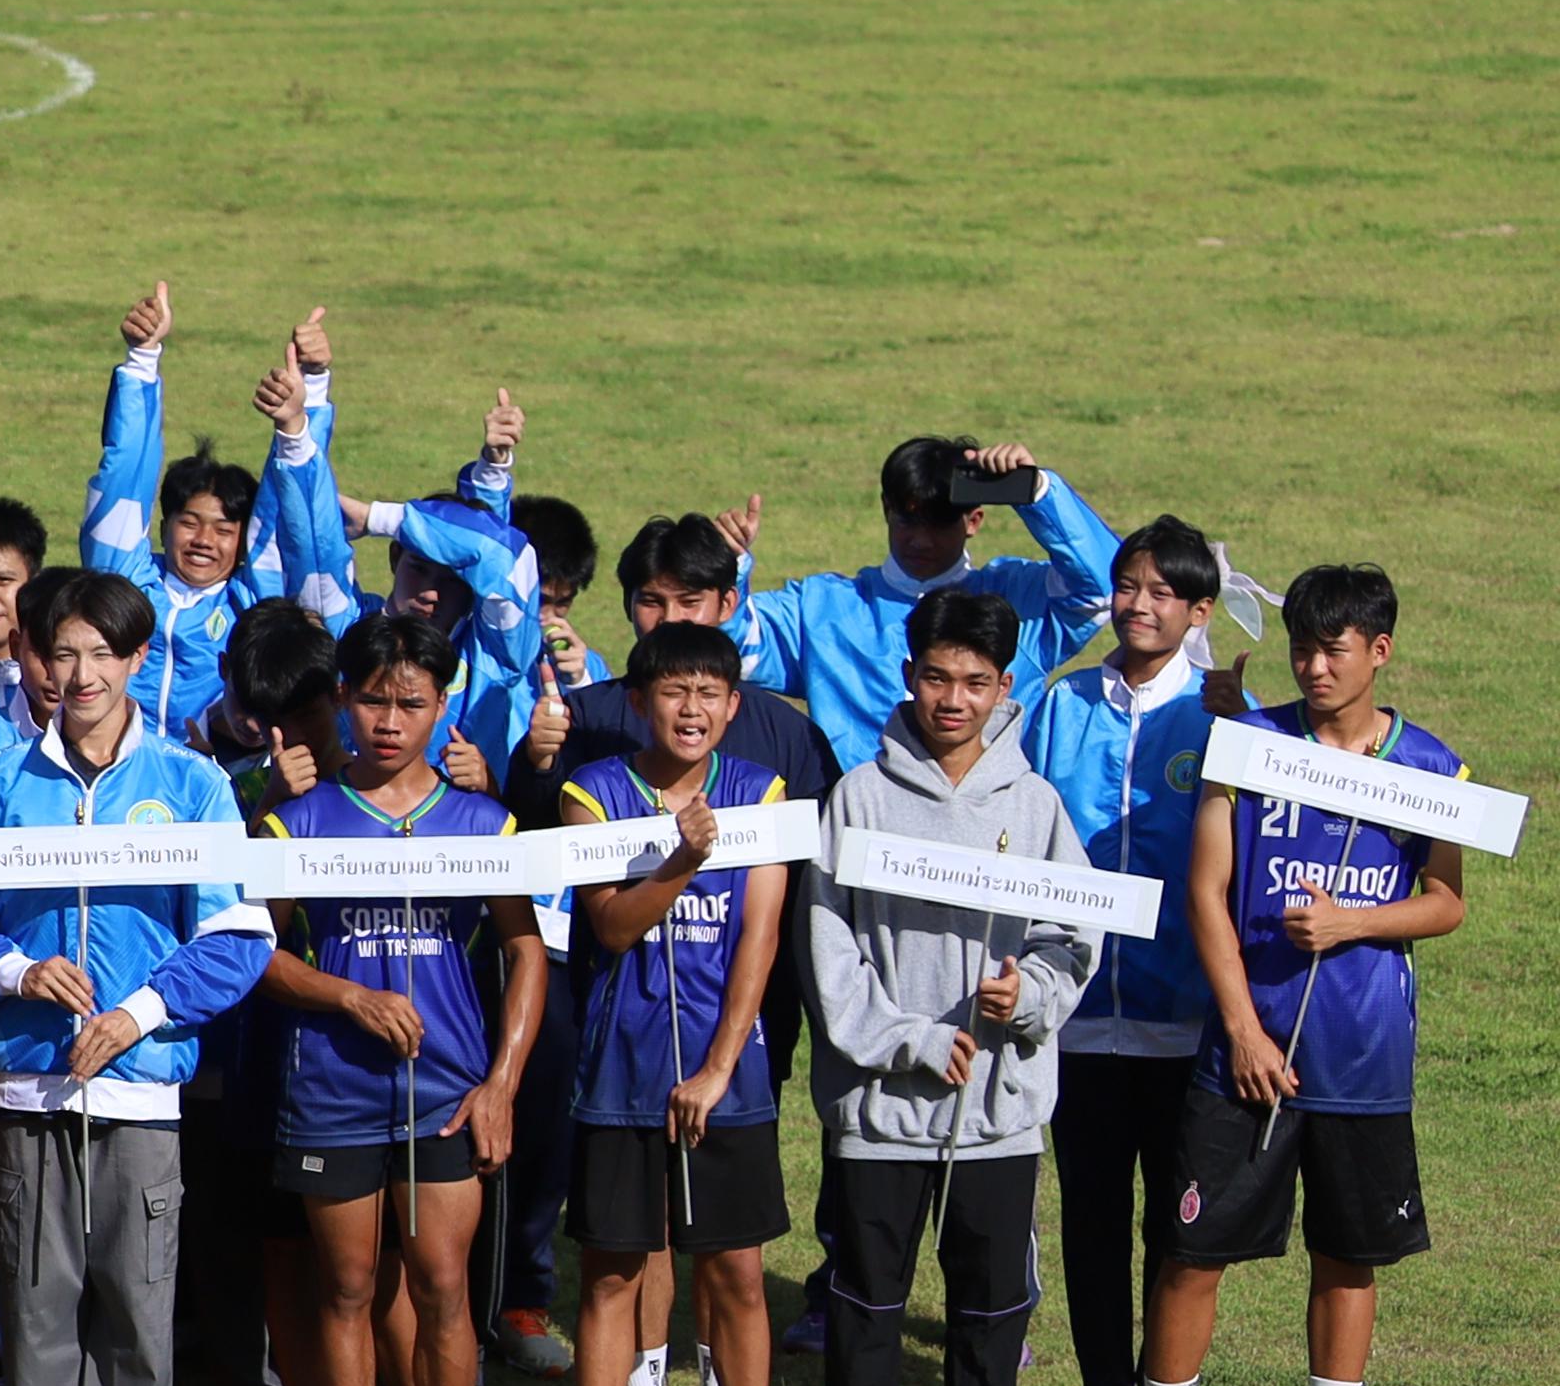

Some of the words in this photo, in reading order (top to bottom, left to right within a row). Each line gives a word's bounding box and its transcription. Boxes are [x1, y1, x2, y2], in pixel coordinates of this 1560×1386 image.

[1264, 748, 1460, 819] โรงเรียนสรรพวิทยาคม
[1260, 795, 1301, 839] 21
[881, 850, 1115, 911] โรงเรียนแม่ระมาดวิทยาคม
